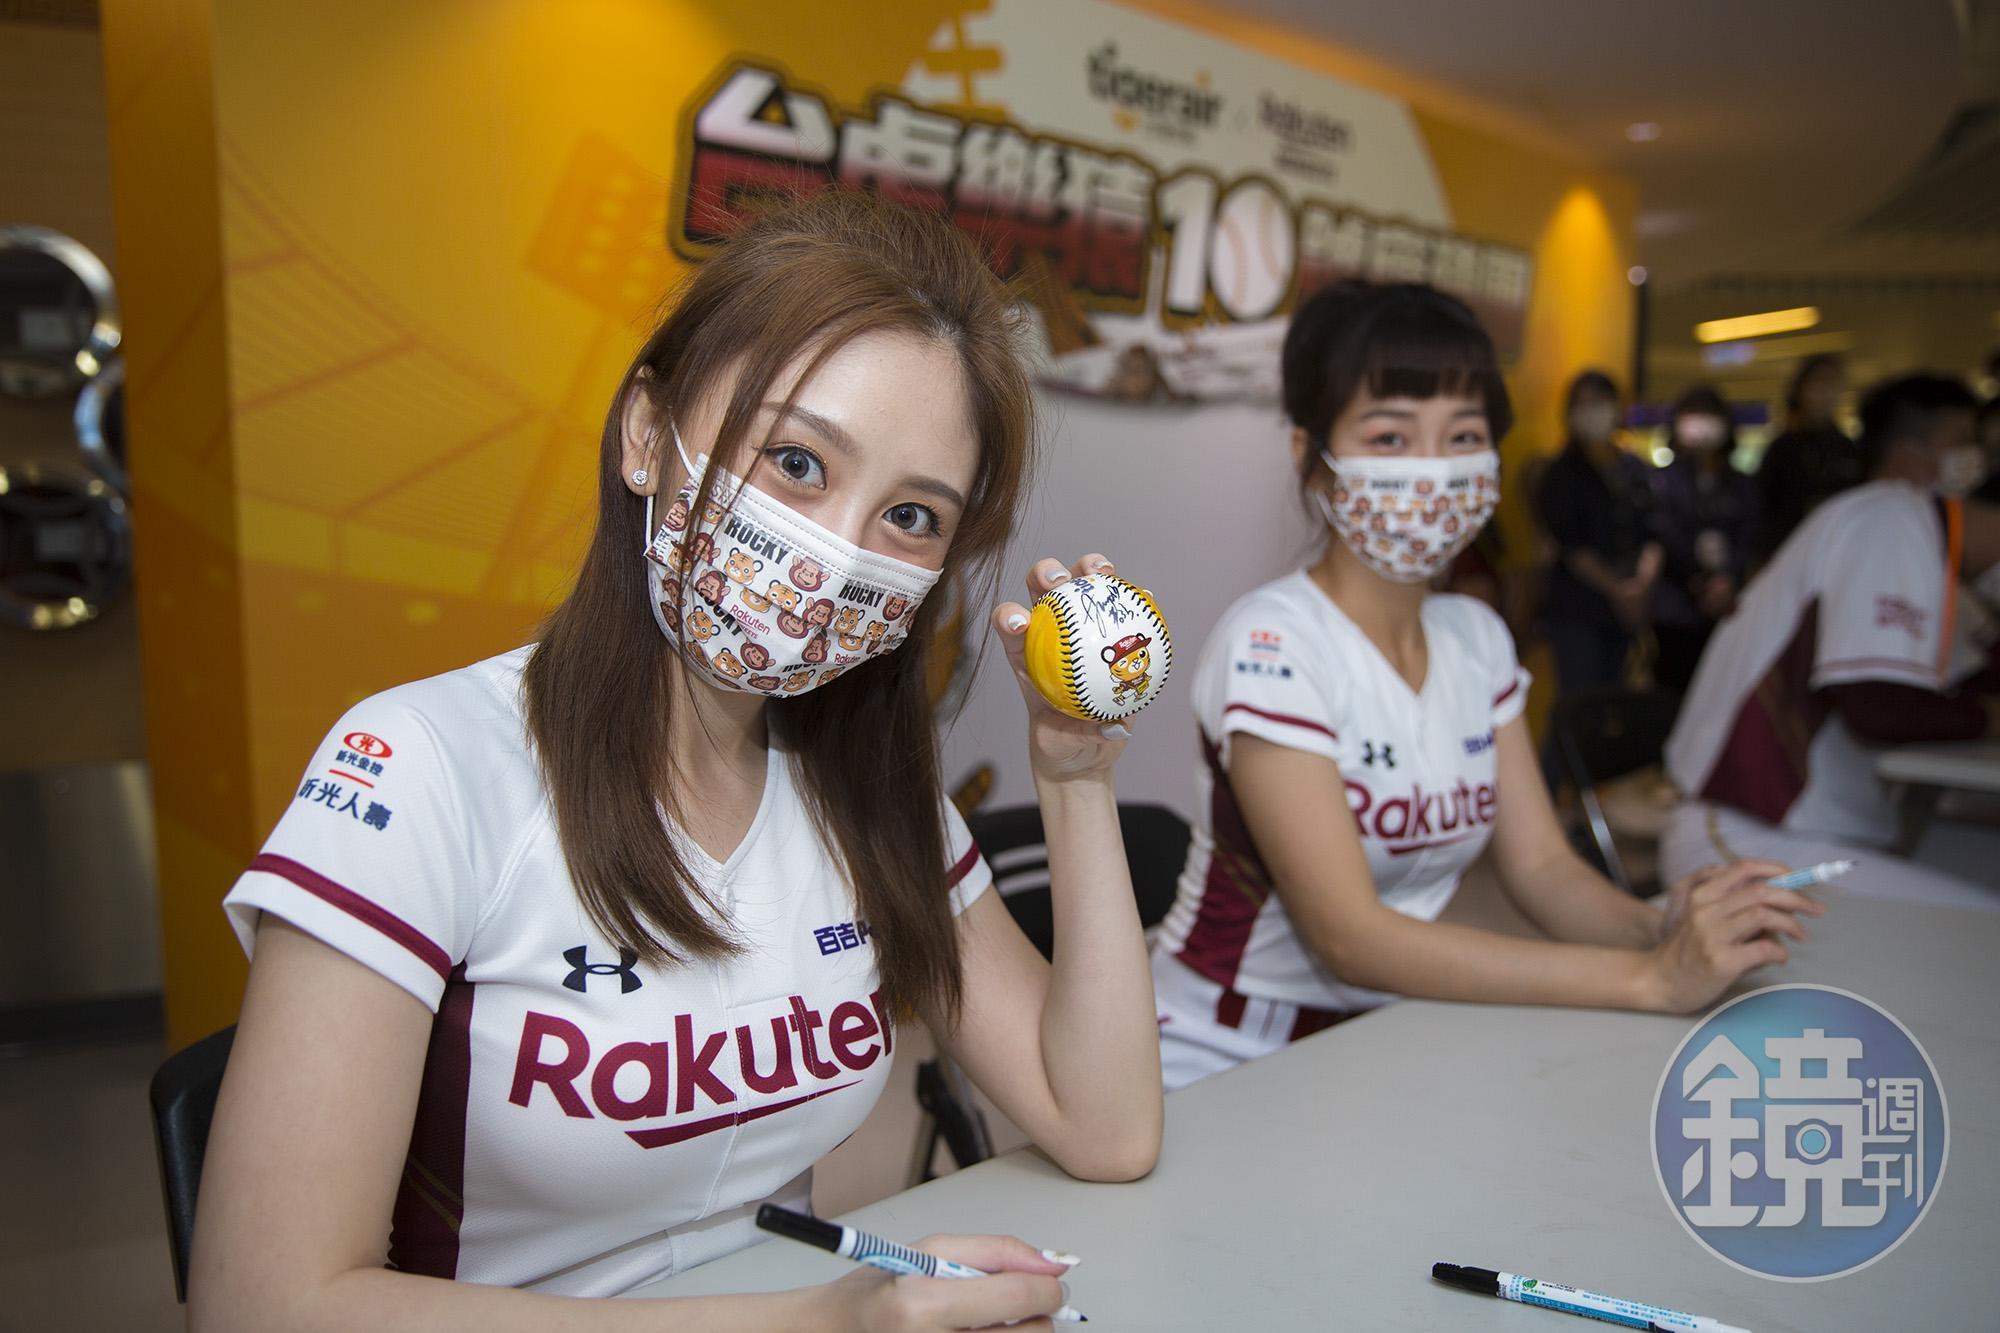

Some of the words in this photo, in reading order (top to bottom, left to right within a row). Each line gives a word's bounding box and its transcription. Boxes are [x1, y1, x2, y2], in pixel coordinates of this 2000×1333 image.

[724, 513, 793, 565] ROCKY
[838, 579, 886, 608] ROCKY
[730, 604, 771, 635] Rakuten
[335, 749, 384, 777] 新光金控
[1343, 777, 1496, 838] Rakute
